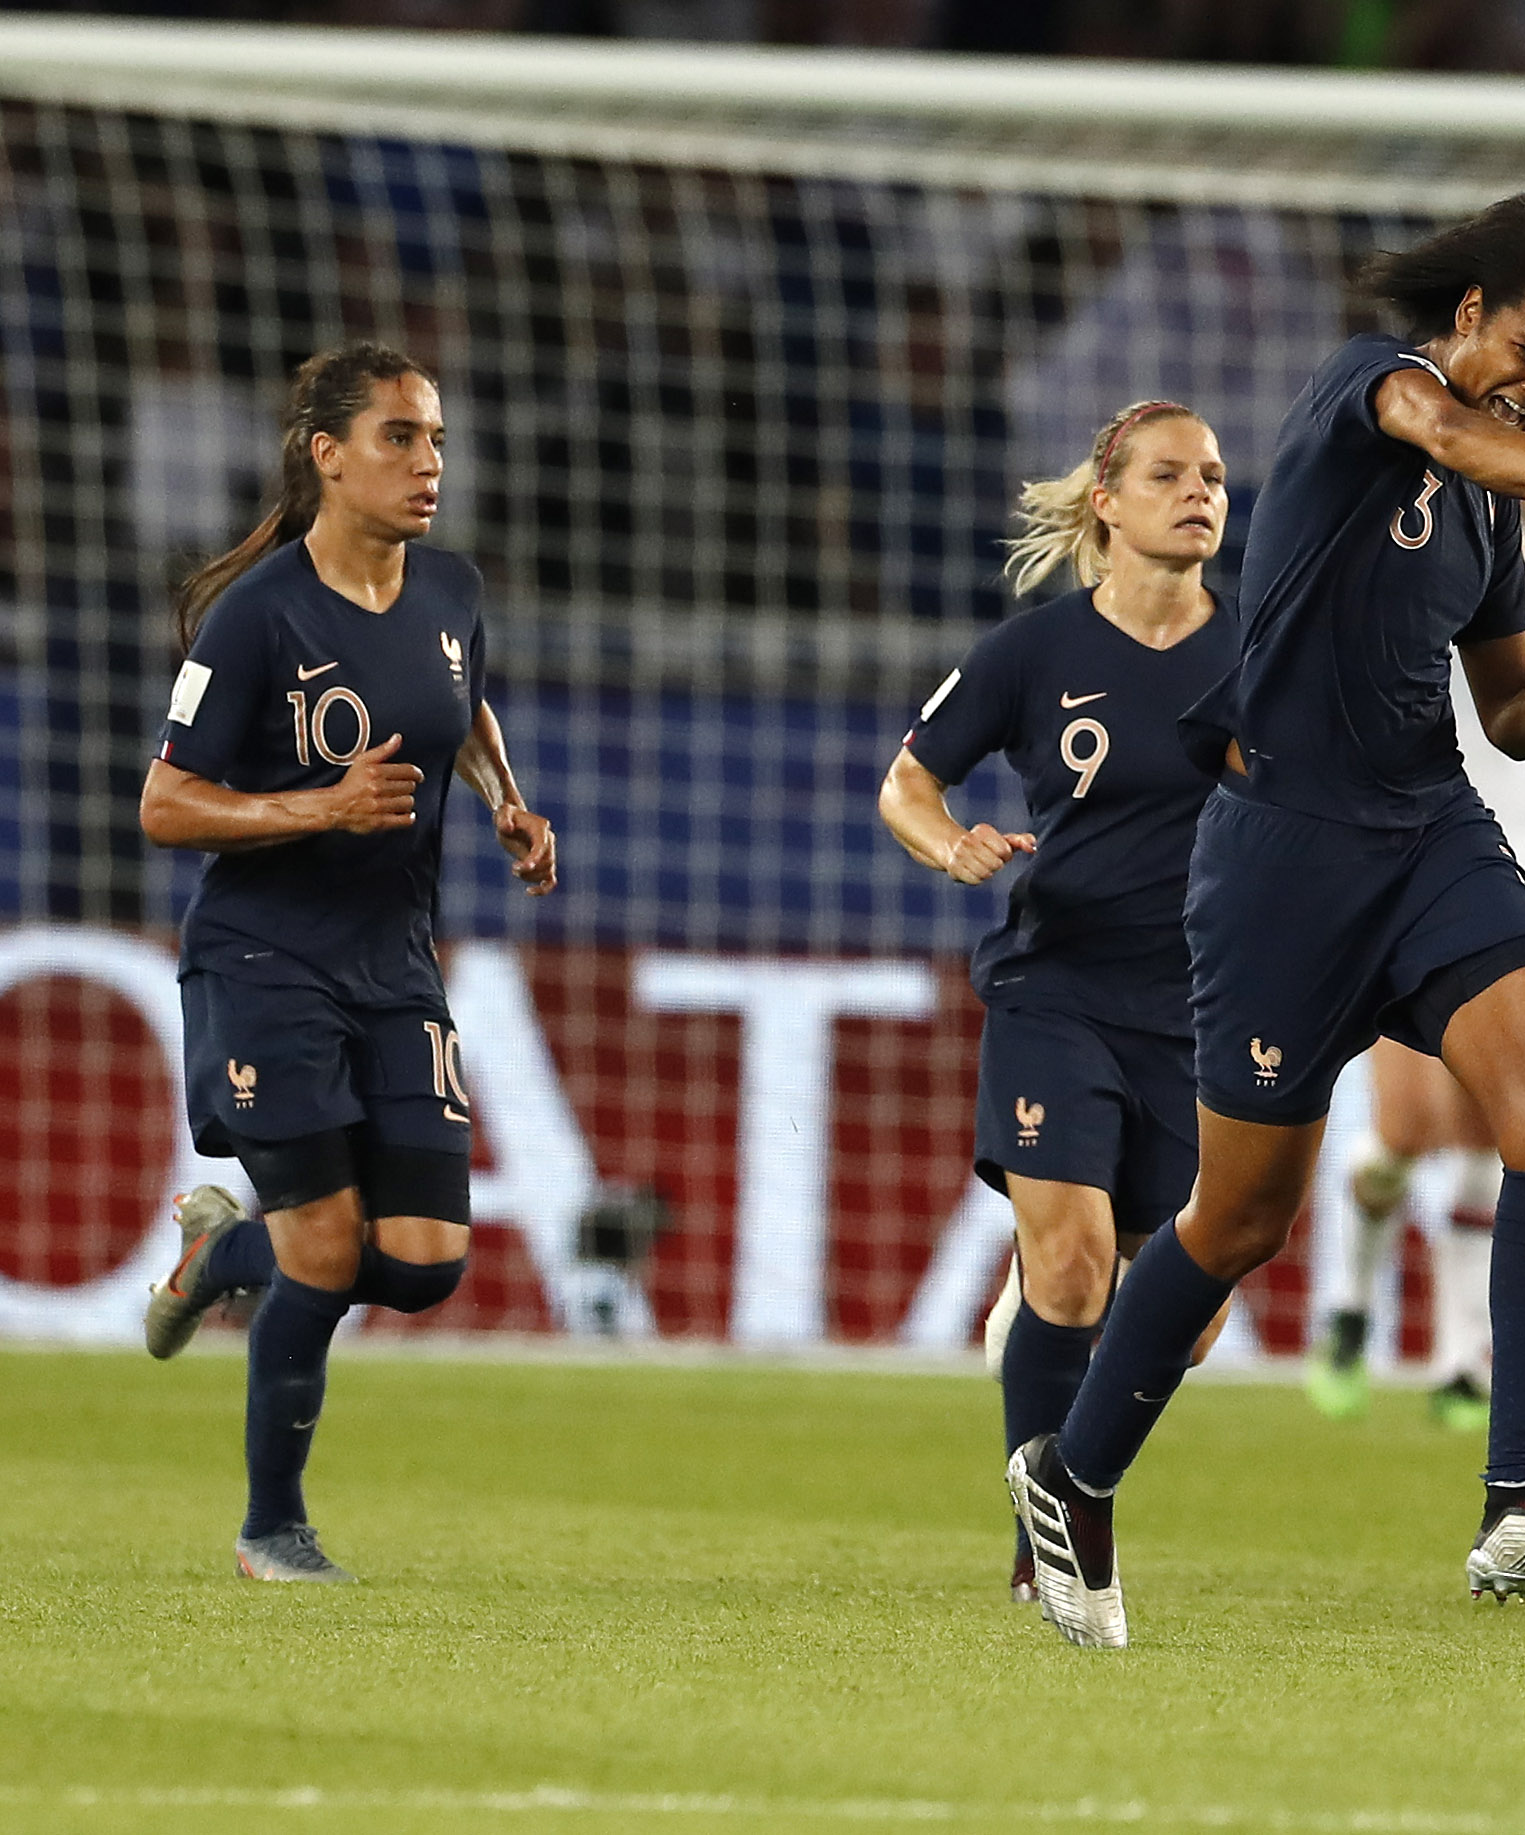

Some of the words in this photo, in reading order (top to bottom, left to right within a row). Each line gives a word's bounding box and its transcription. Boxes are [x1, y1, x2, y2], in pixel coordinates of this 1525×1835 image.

[1389, 469, 1443, 549] 3
[287, 686, 371, 767] 10
[1060, 718, 1110, 798] 9
